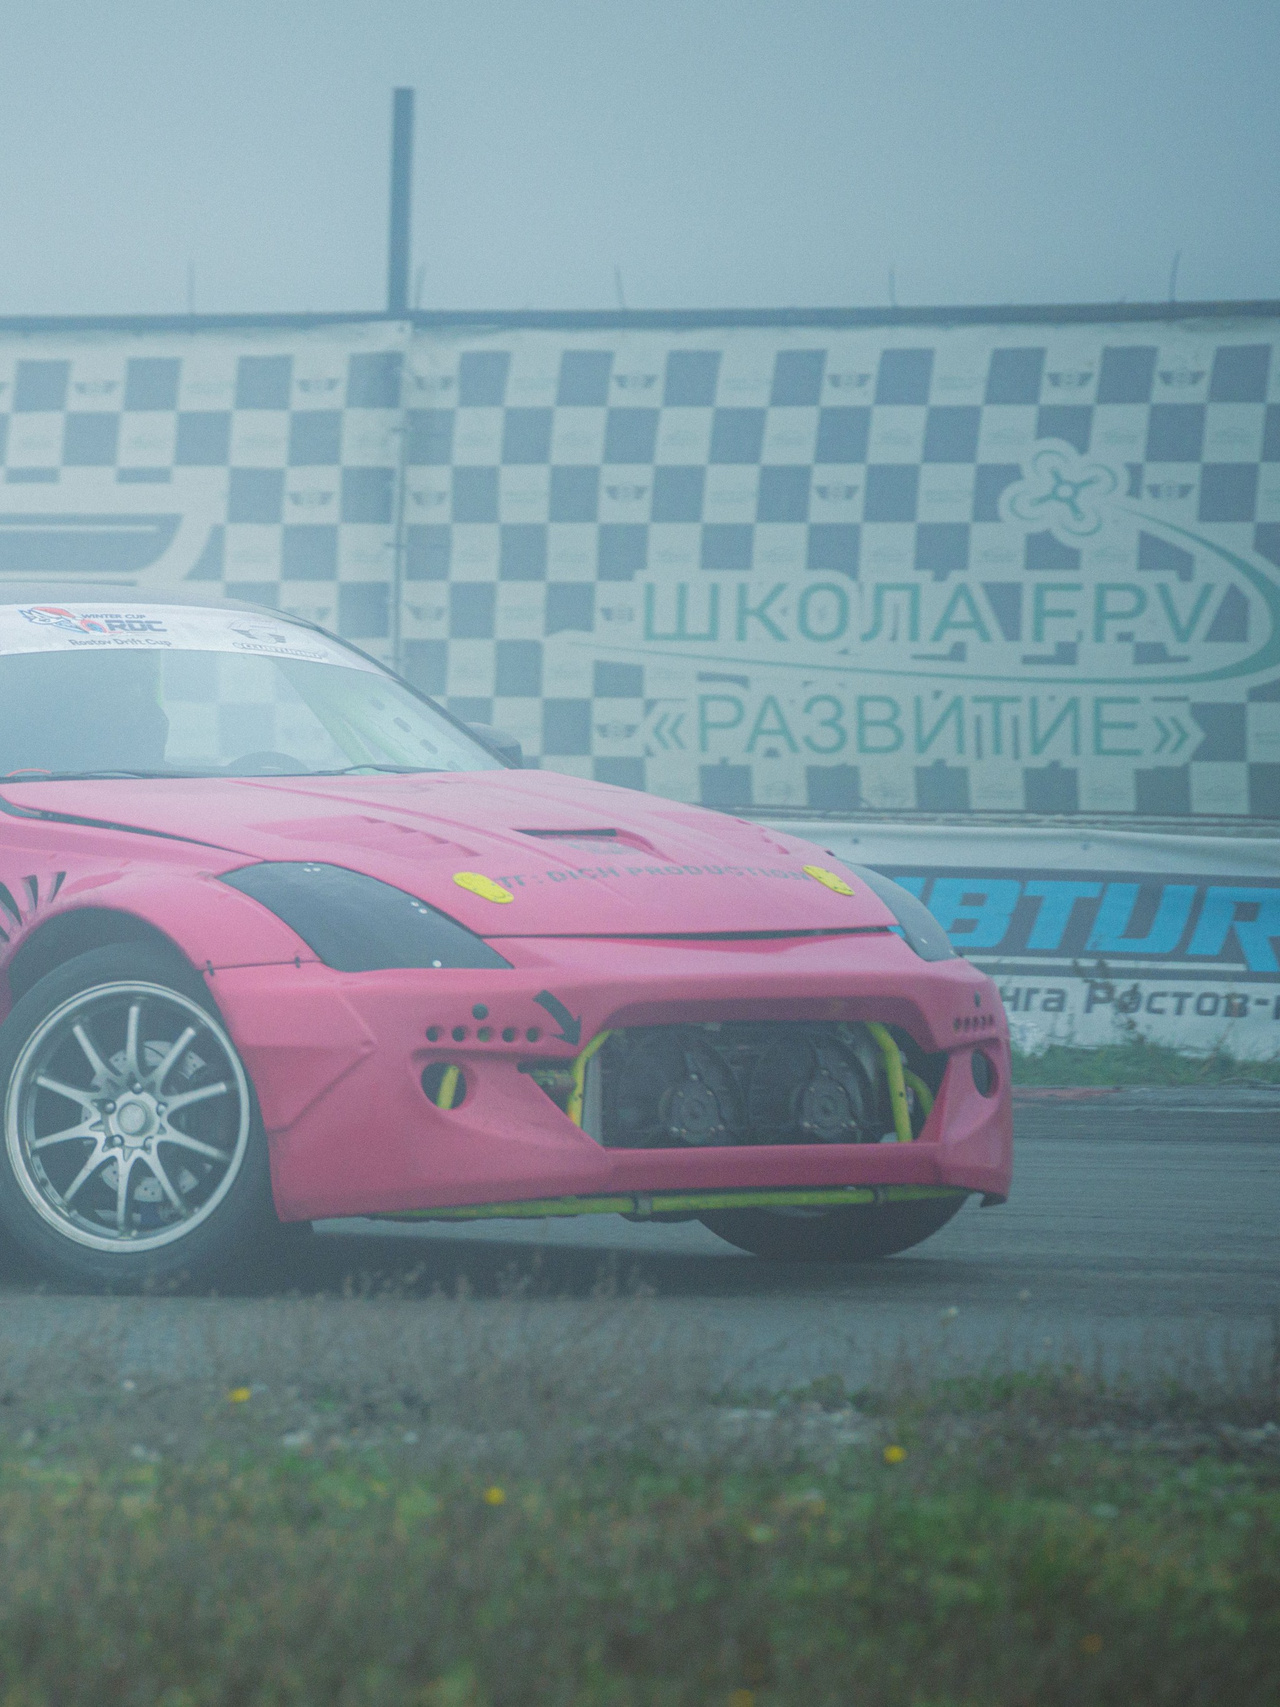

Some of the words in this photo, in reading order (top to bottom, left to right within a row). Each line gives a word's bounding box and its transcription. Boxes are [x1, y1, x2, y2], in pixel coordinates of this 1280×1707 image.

[644, 582, 992, 643] ШКОЛА
[1032, 582, 1216, 644] FPV
[67, 637, 112, 647] Rostov
[113, 637, 142, 646] Drift
[145, 637, 172, 648] Cup
[652, 694, 1190, 757] «РАЗВИТИЕ»
[1083, 980, 1280, 1020] Ростов-
